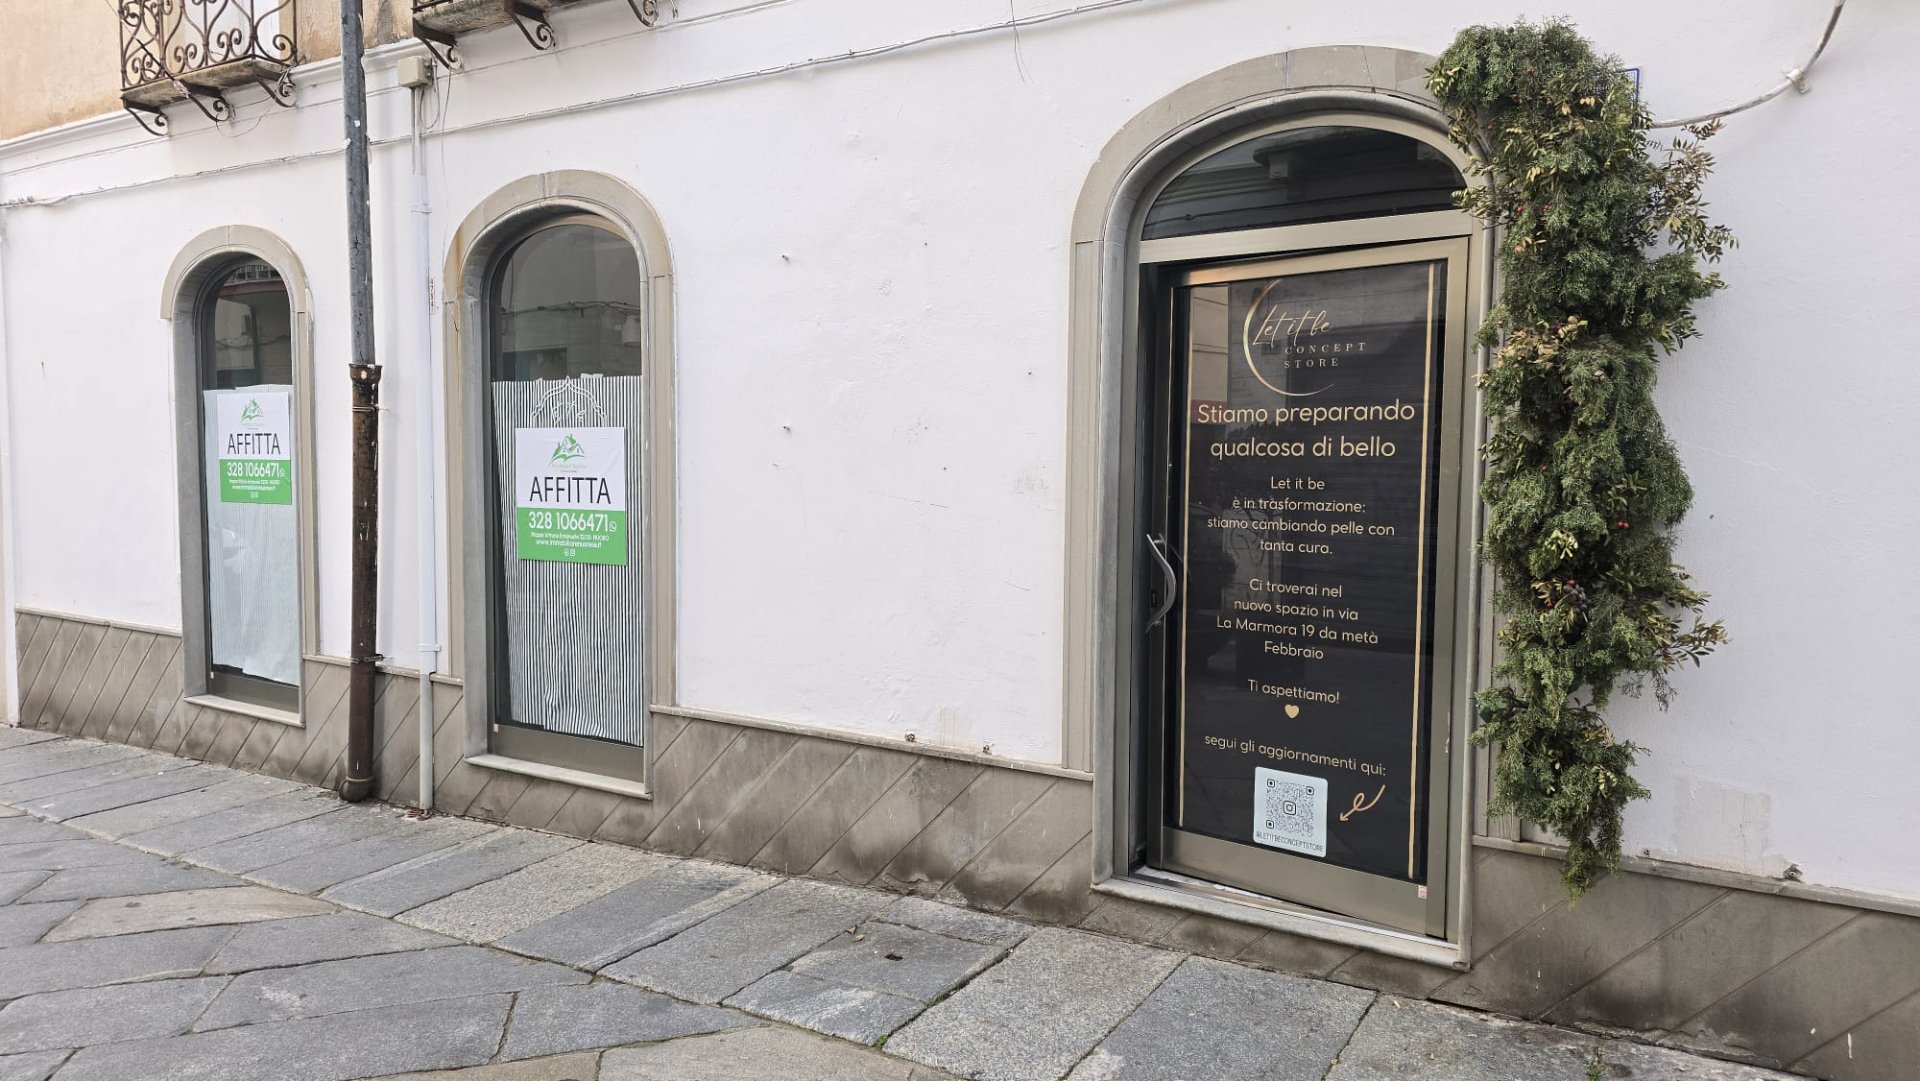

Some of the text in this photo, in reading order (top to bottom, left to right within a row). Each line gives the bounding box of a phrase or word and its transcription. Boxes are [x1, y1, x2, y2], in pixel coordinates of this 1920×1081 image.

[1253, 304, 1288, 348] Let
[1309, 310, 1330, 336] be
[1284, 342, 1366, 355] CONCEPT
[1284, 357, 1338, 369] STORE
[1197, 398, 1415, 426] Stiamo preparando
[227, 433, 281, 455] AFFITTA
[1210, 435, 1396, 460] qualcosa di bello
[227, 462, 280, 478] 328 1066471
[530, 476, 611, 504] AFFITTA
[1270, 476, 1325, 490] Let it be
[1232, 496, 1366, 513] è in trasformazione:
[528, 511, 608, 532] 328 1066471
[1207, 516, 1395, 536] stiamo cambiando pelle con
[1259, 539, 1333, 554] tanta cura.
[1249, 578, 1342, 598] Ci troverai nel
[1234, 600, 1359, 621] nuovo spazio in via
[1216, 615, 1379, 644] La Marmora 19 da metà
[1264, 640, 1324, 660] Febbraio
[1248, 679, 1340, 704] Ti aspettiamo!
[1205, 735, 1386, 777] segui gli aggiornamenti qui:
